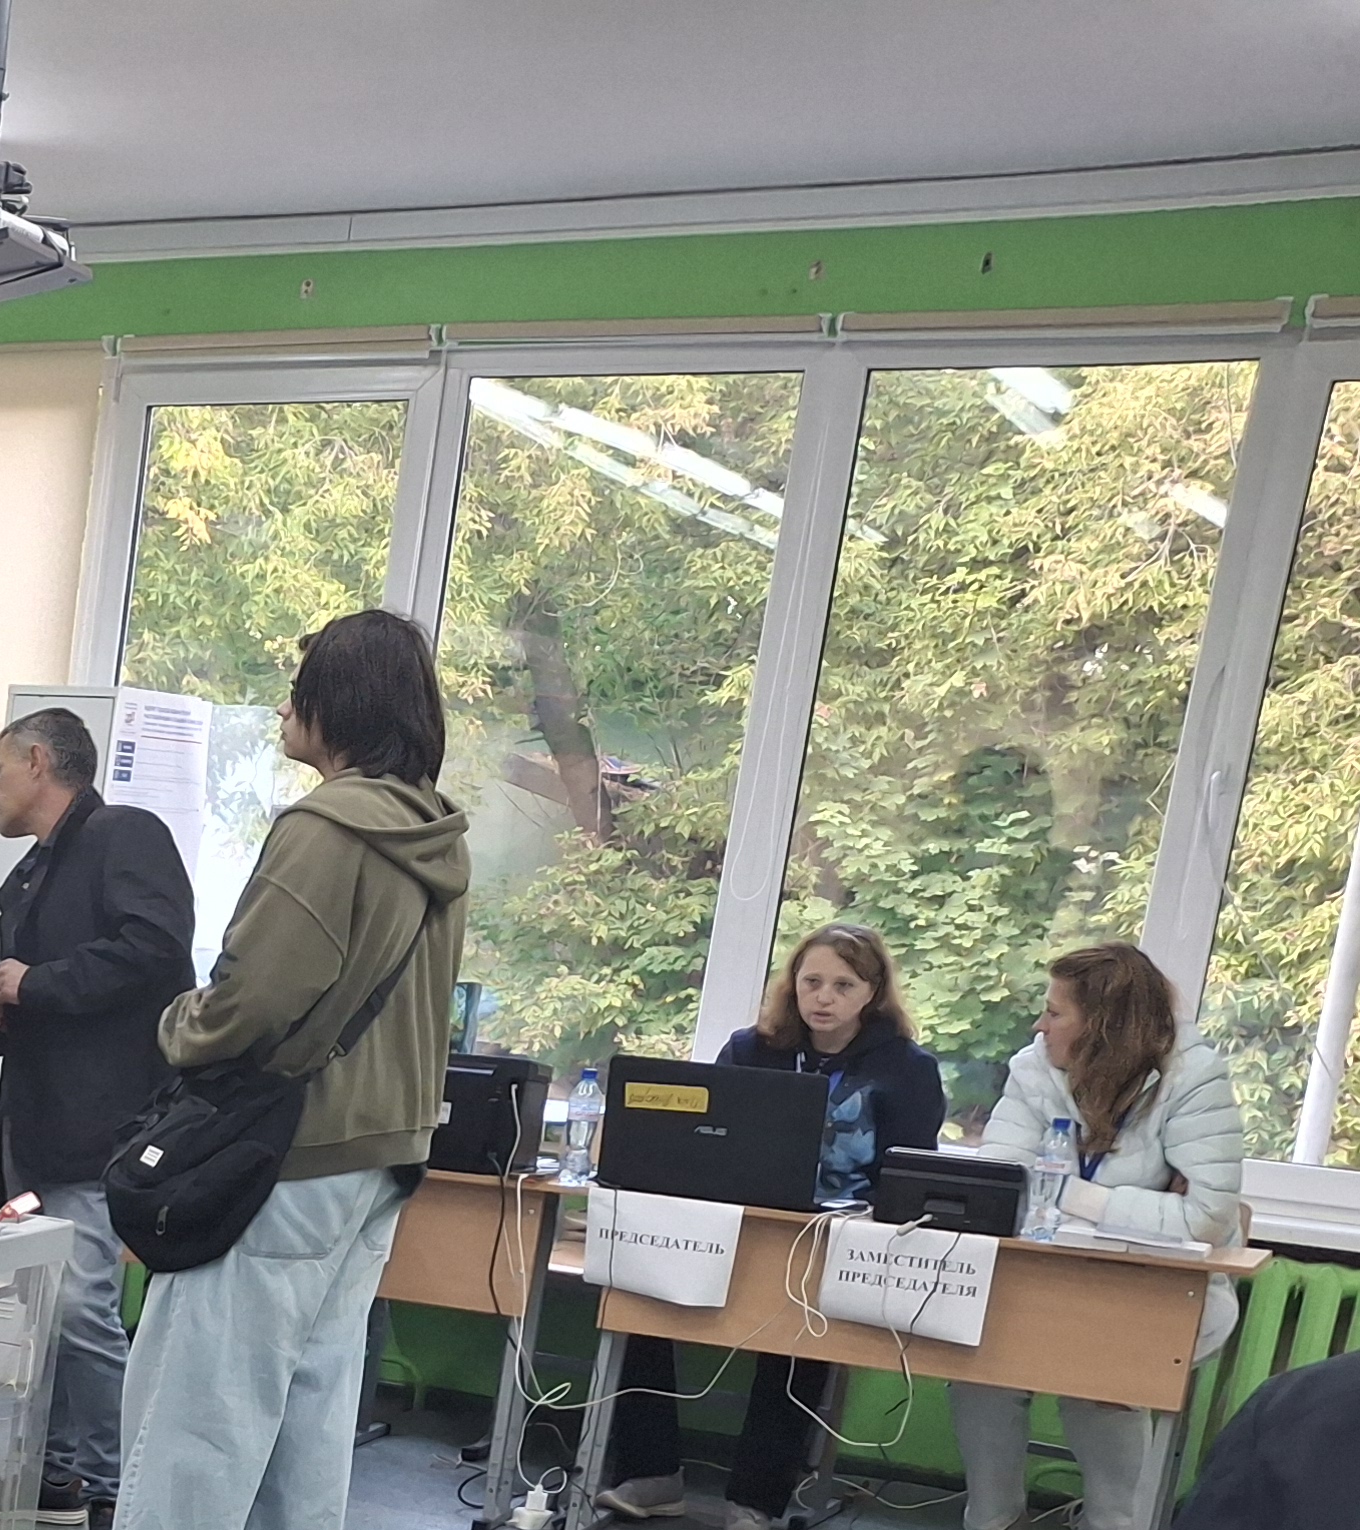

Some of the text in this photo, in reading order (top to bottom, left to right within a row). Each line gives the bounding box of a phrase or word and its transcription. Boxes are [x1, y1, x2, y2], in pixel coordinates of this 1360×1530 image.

[599, 1228, 725, 1255] ПРЕДСЕДАТЕЛЬ
[847, 1248, 977, 1275] ЗАМЕСТИТЕЛЬ
[838, 1269, 977, 1298] ПРЕДСЕДАТЕЛЯ
